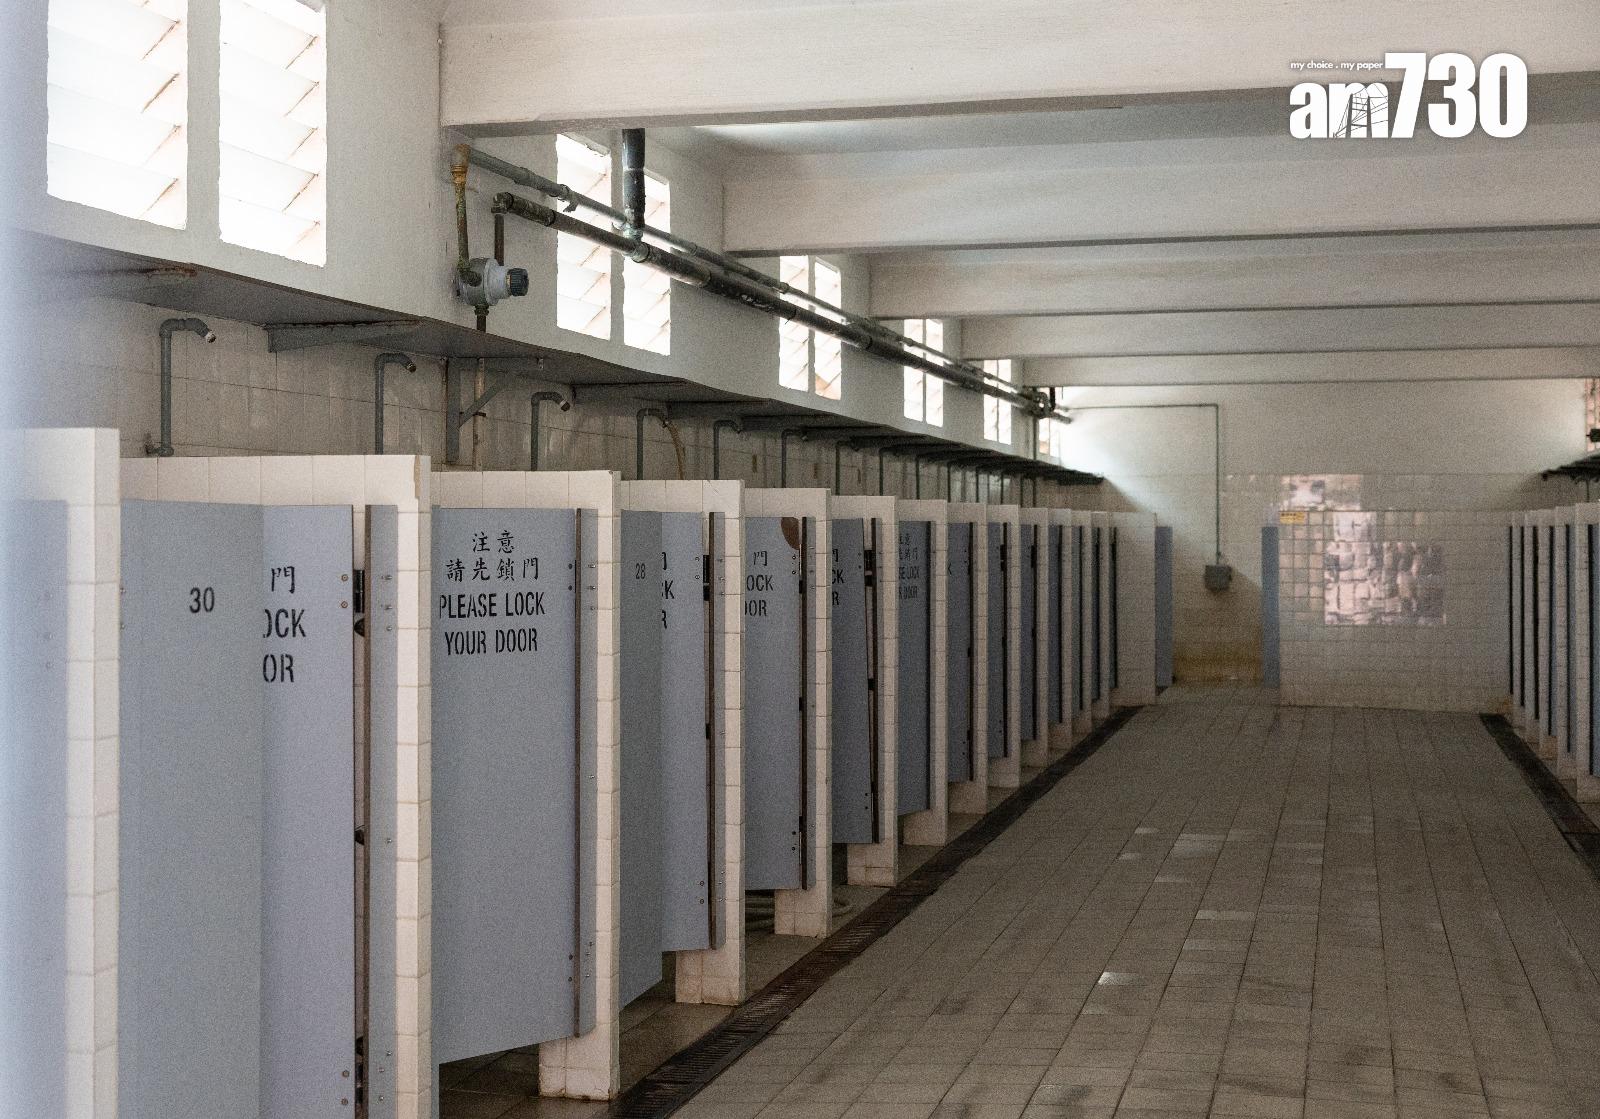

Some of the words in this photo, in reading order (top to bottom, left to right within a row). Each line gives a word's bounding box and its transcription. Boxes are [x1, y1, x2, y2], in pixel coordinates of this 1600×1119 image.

[472, 529, 515, 554] 注意
[271, 565, 296, 594] 門
[446, 557, 539, 582] 請先鎖門
[635, 562, 646, 580] 28
[746, 574, 774, 591] OCK
[189, 586, 215, 614] 30
[439, 593, 498, 619] PLEASE
[505, 591, 546, 617] LOCK
[444, 630, 487, 656] YOUR
[495, 627, 538, 653] DOOR
[262, 653, 295, 683] OR
